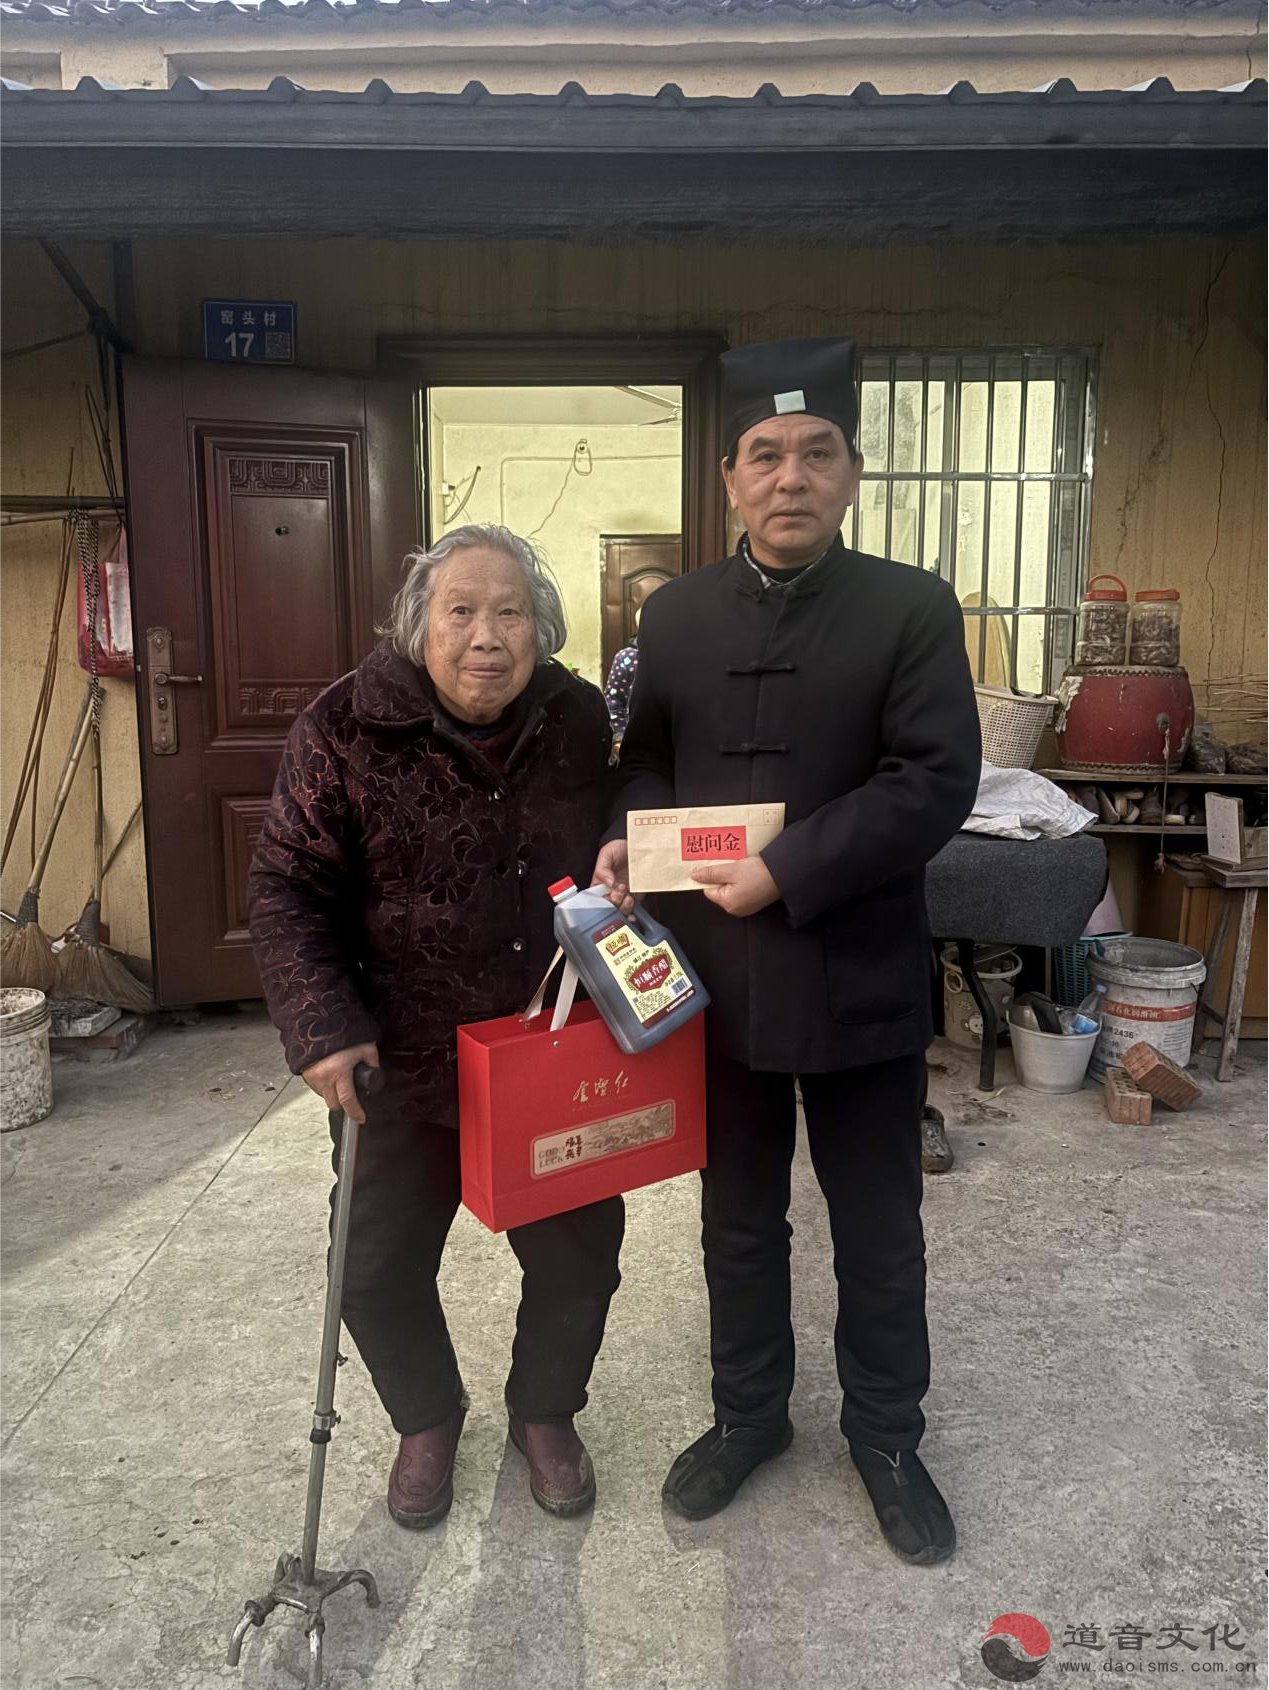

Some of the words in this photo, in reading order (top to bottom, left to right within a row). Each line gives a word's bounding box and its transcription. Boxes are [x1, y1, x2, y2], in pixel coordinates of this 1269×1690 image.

[225, 332, 255, 357] 17
[686, 833, 741, 853] 慰问金
